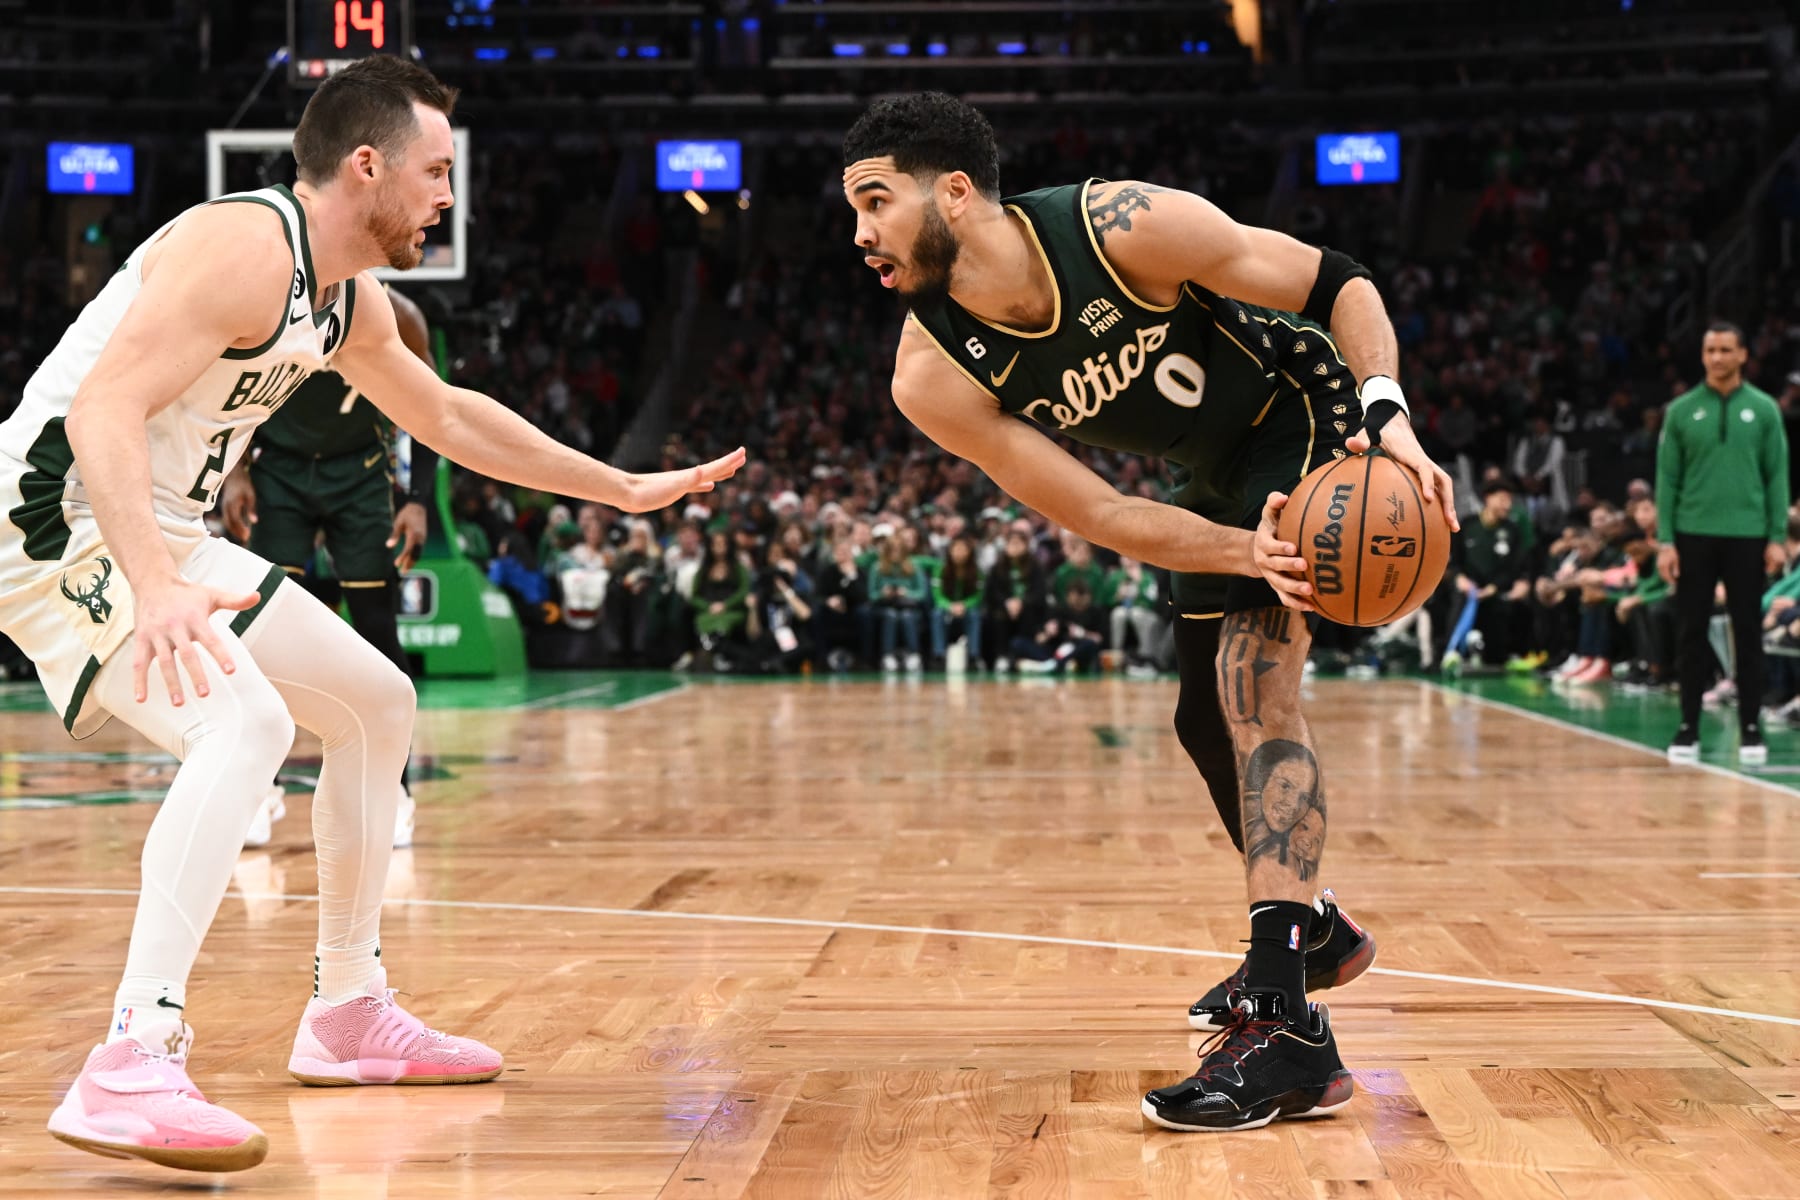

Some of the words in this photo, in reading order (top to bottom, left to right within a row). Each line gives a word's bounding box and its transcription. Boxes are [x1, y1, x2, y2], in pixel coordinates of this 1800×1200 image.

[334, 0, 384, 48] 14
[1078, 297, 1116, 327] VISTA
[1089, 307, 1124, 338] PRINT
[965, 336, 987, 359] 6
[1022, 322, 1171, 429] Celtics
[1153, 353, 1206, 408] 0
[186, 427, 236, 503] 2
[1313, 483, 1356, 596] Wilson
